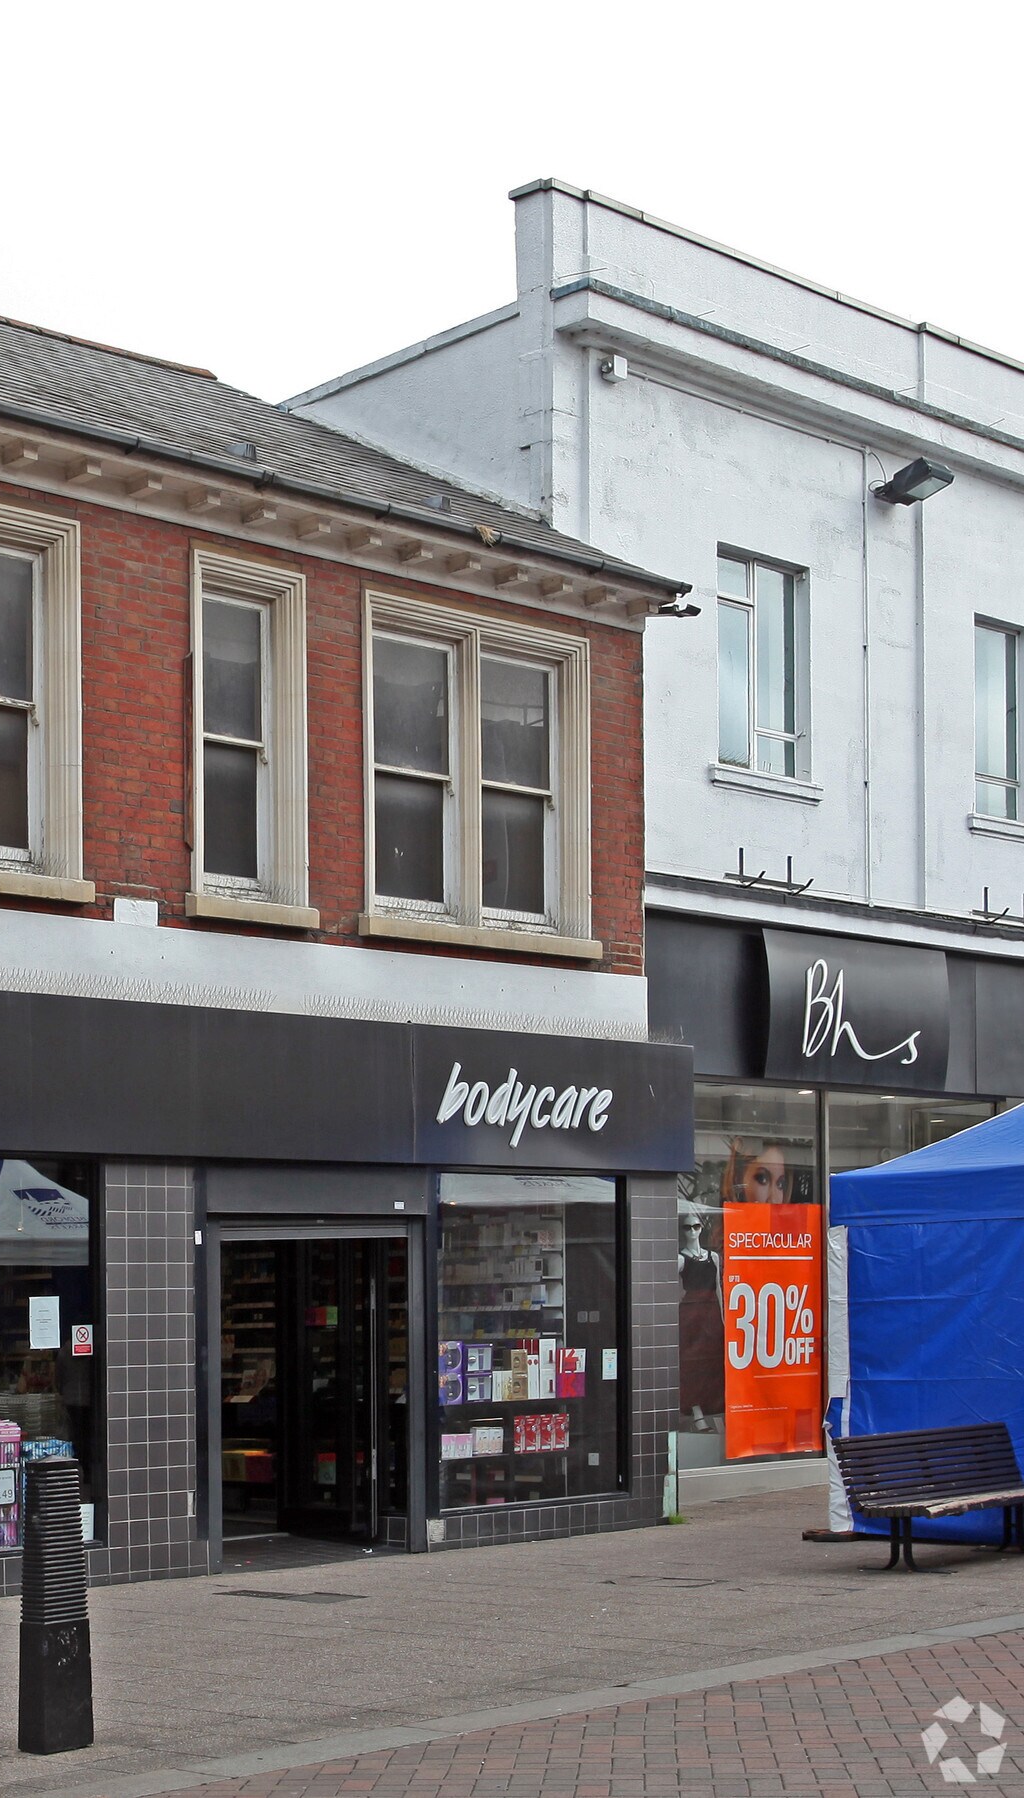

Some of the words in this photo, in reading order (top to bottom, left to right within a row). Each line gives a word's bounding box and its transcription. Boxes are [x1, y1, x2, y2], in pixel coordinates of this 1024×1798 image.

[801, 957, 922, 1066] Bhs
[436, 1061, 614, 1149] bodycare
[728, 1232, 812, 1249] SPECTACULAR
[728, 1282, 814, 1370] 30%
[784, 1337, 814, 1366] OFF
